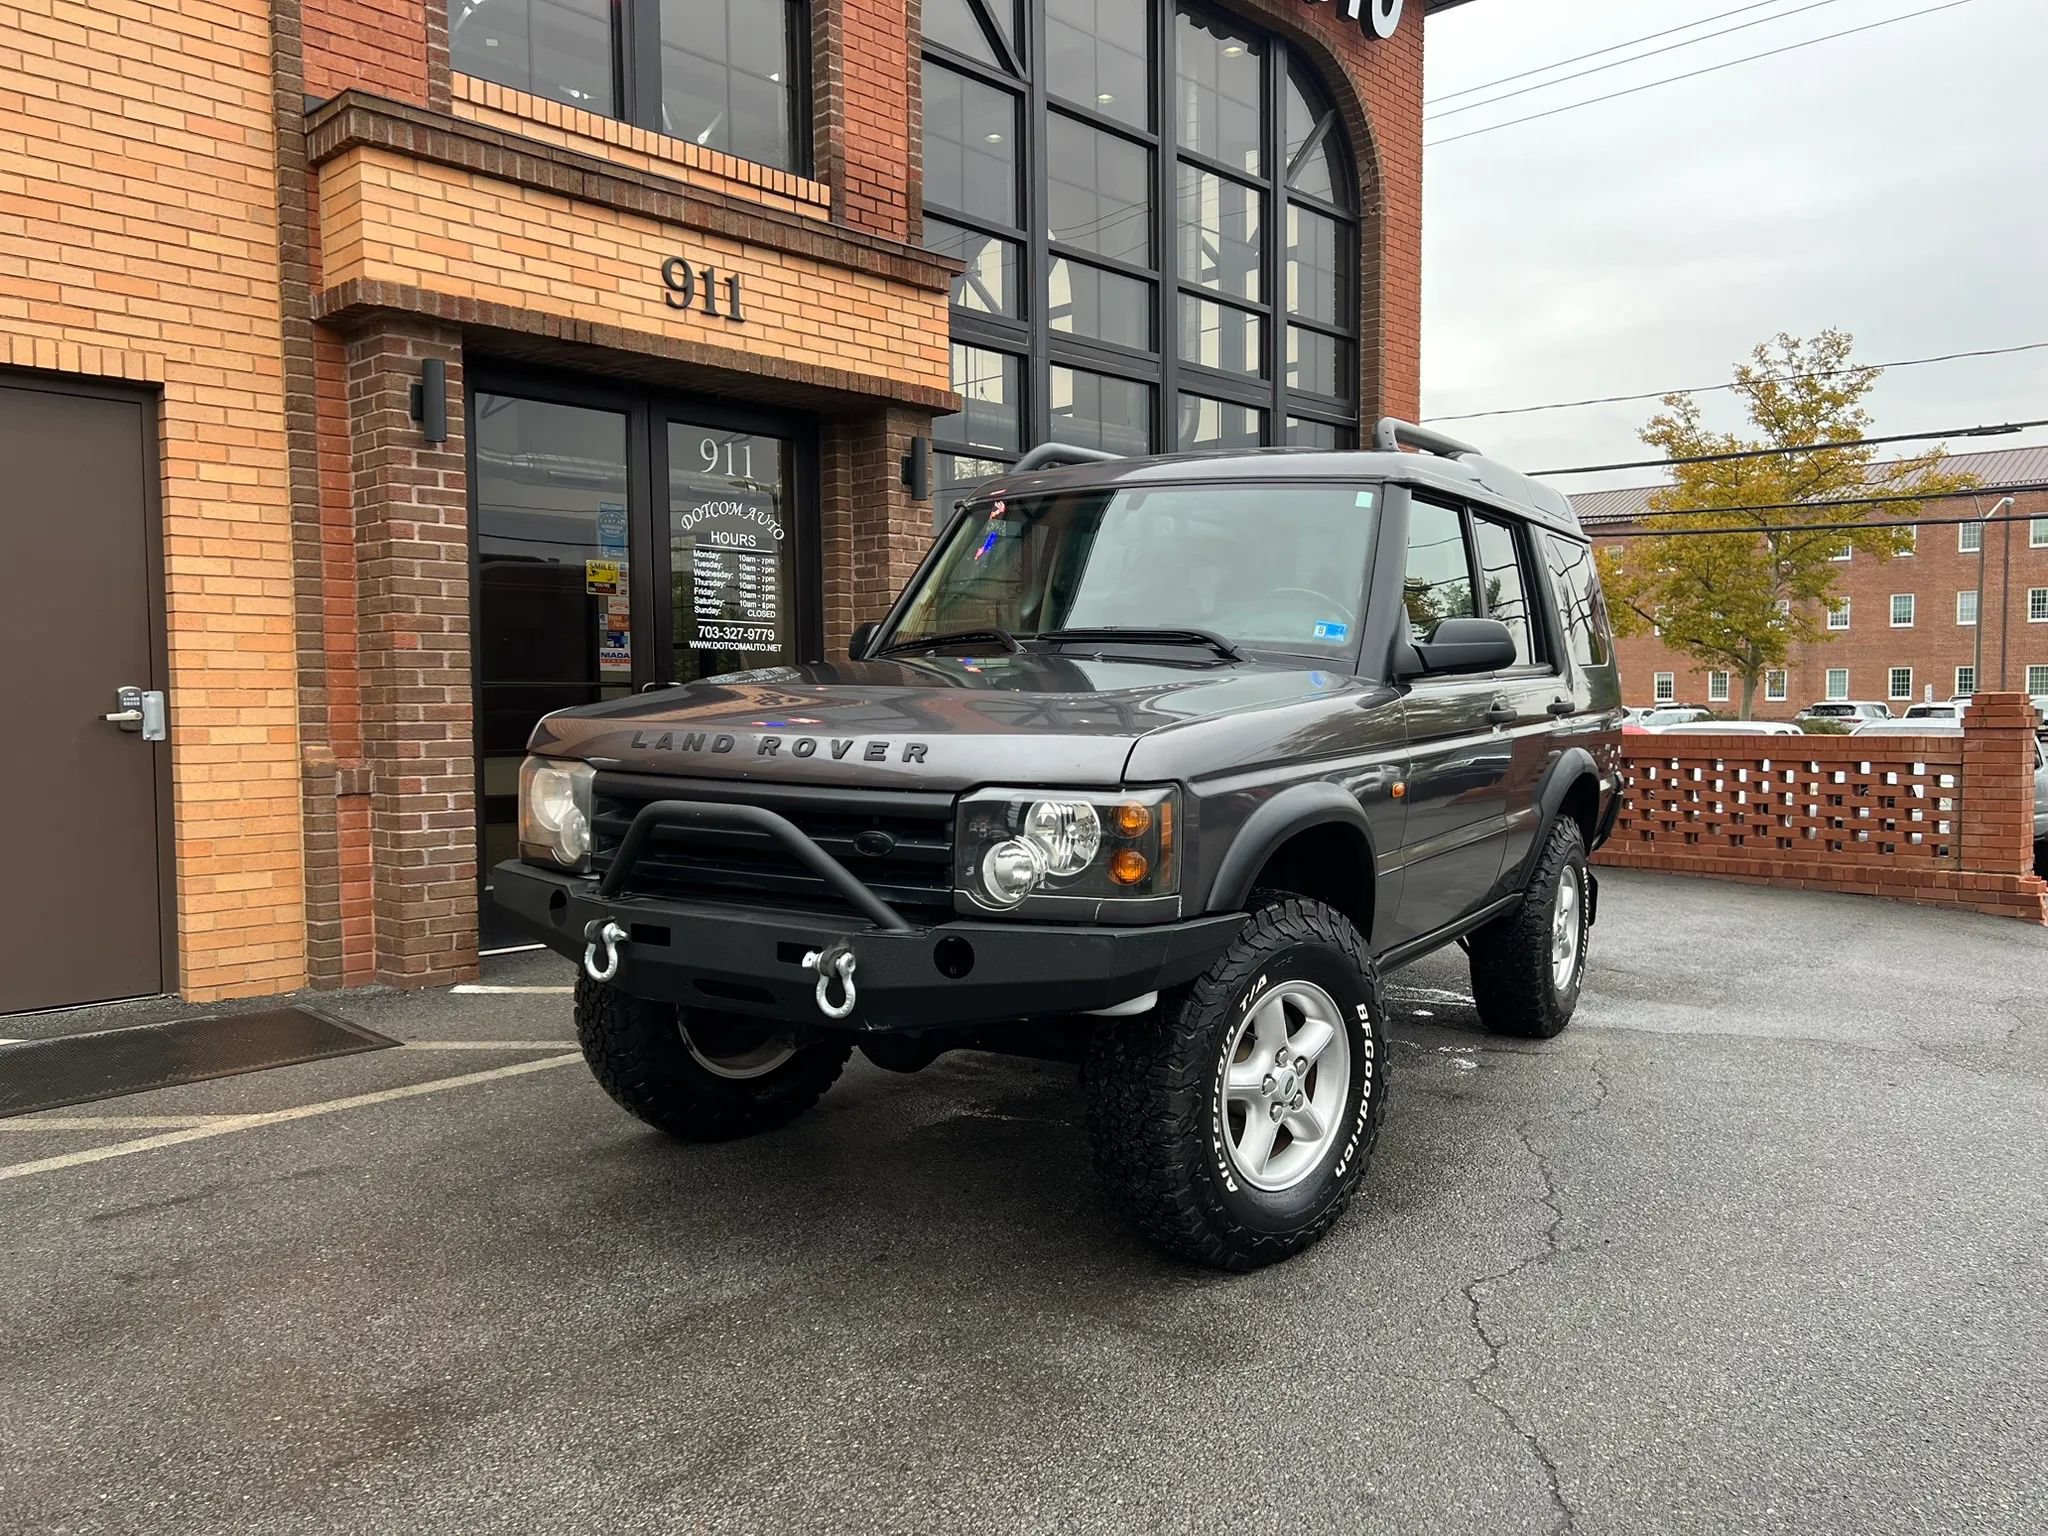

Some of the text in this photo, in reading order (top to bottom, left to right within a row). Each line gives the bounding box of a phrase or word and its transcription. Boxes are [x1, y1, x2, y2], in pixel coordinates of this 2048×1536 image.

[661, 255, 746, 323] 911
[700, 438, 754, 479] 911
[681, 501, 785, 540] DOTCOM AUTO
[710, 531, 757, 547] HOURS
[739, 573, 756, 581] 10am
[739, 582, 756, 590] 10am
[747, 609, 776, 618] CLOSED
[698, 626, 775, 641] 703-327-9779
[689, 640, 783, 652] WWW.DOTCOMAUTO.NET
[631, 730, 929, 763] LAND ROVER
[1212, 974, 1267, 1193] All-Terrain T/A
[1334, 1003, 1374, 1178] BFGoodrich
